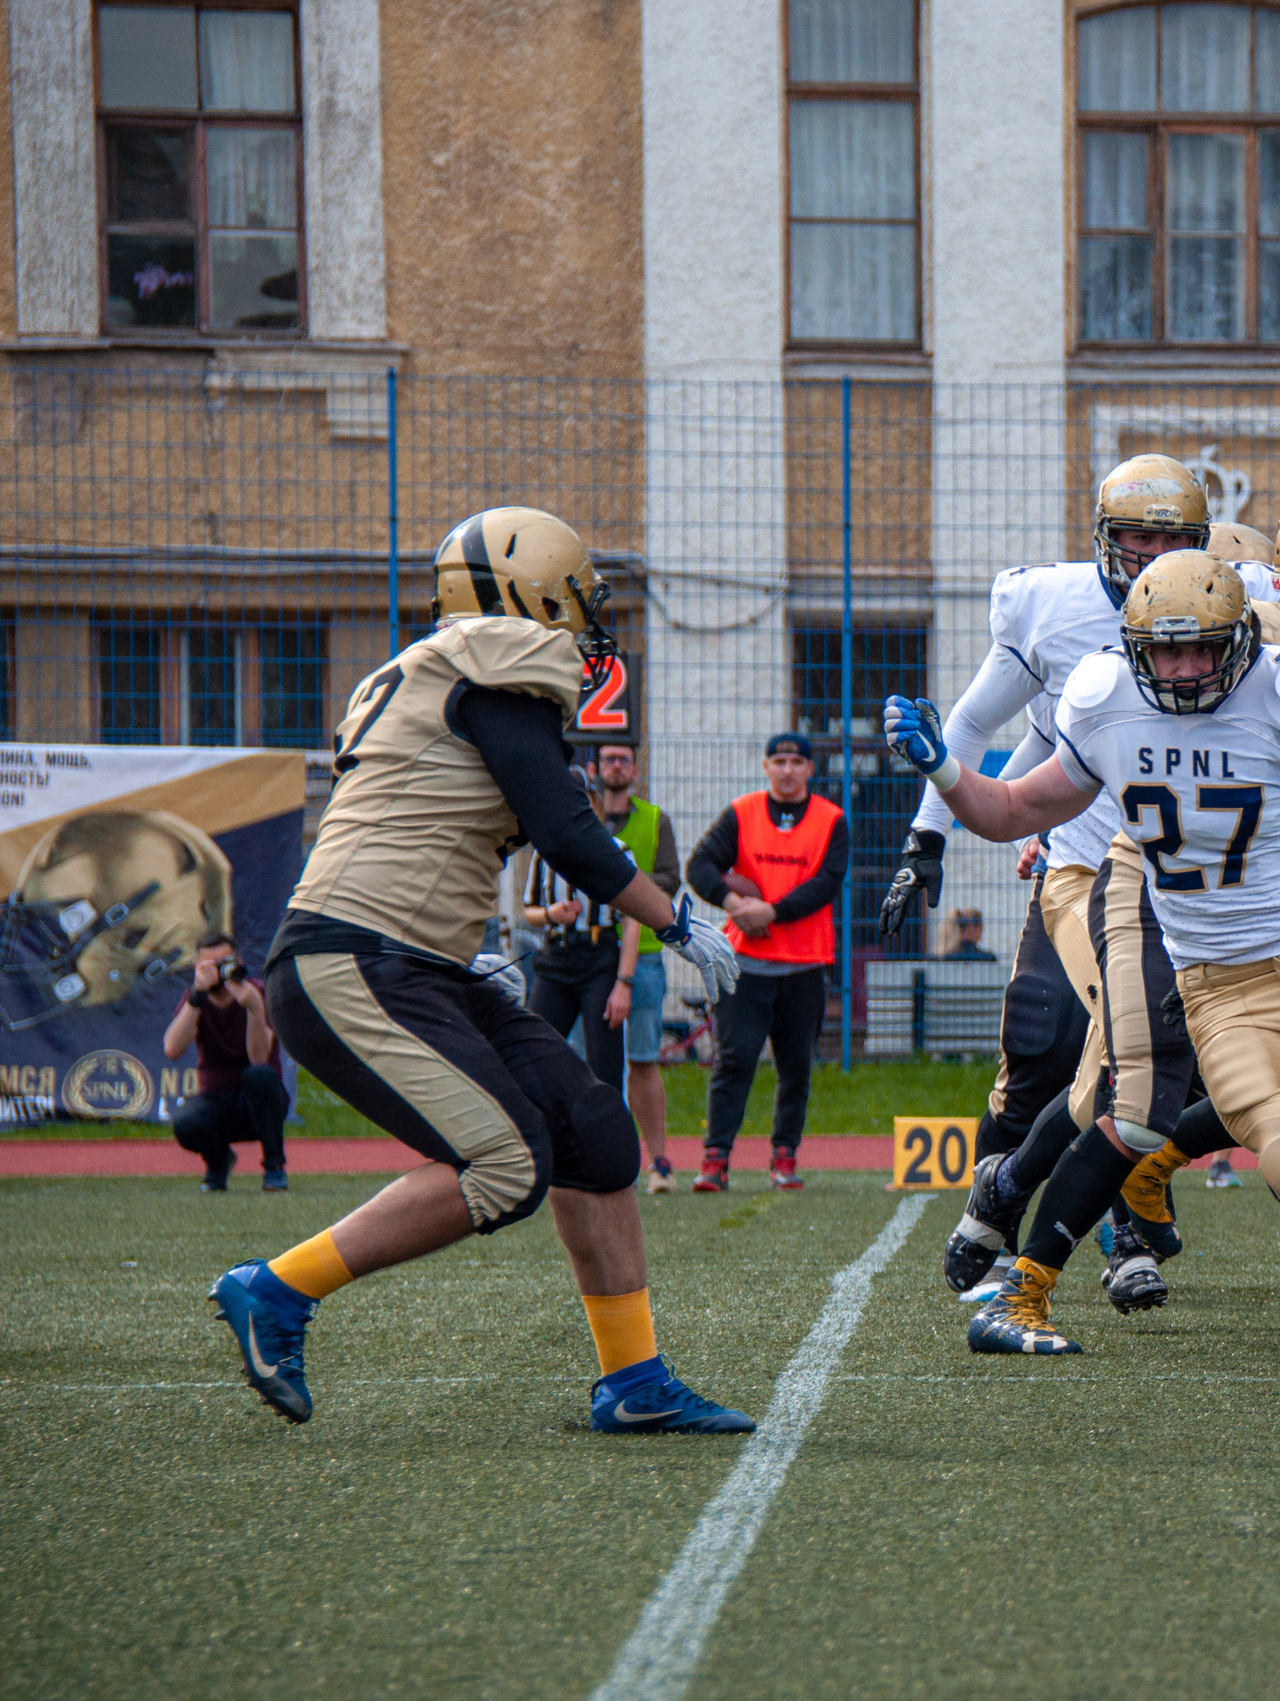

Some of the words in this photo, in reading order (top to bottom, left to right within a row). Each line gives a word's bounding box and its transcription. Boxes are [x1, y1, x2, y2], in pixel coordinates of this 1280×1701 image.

[577, 655, 627, 729] 2
[1138, 747, 1235, 778] SPNL
[1119, 781, 1265, 894] 27
[0, 1095, 56, 1122] ИТЕР!
[903, 1125, 967, 1184] 20
